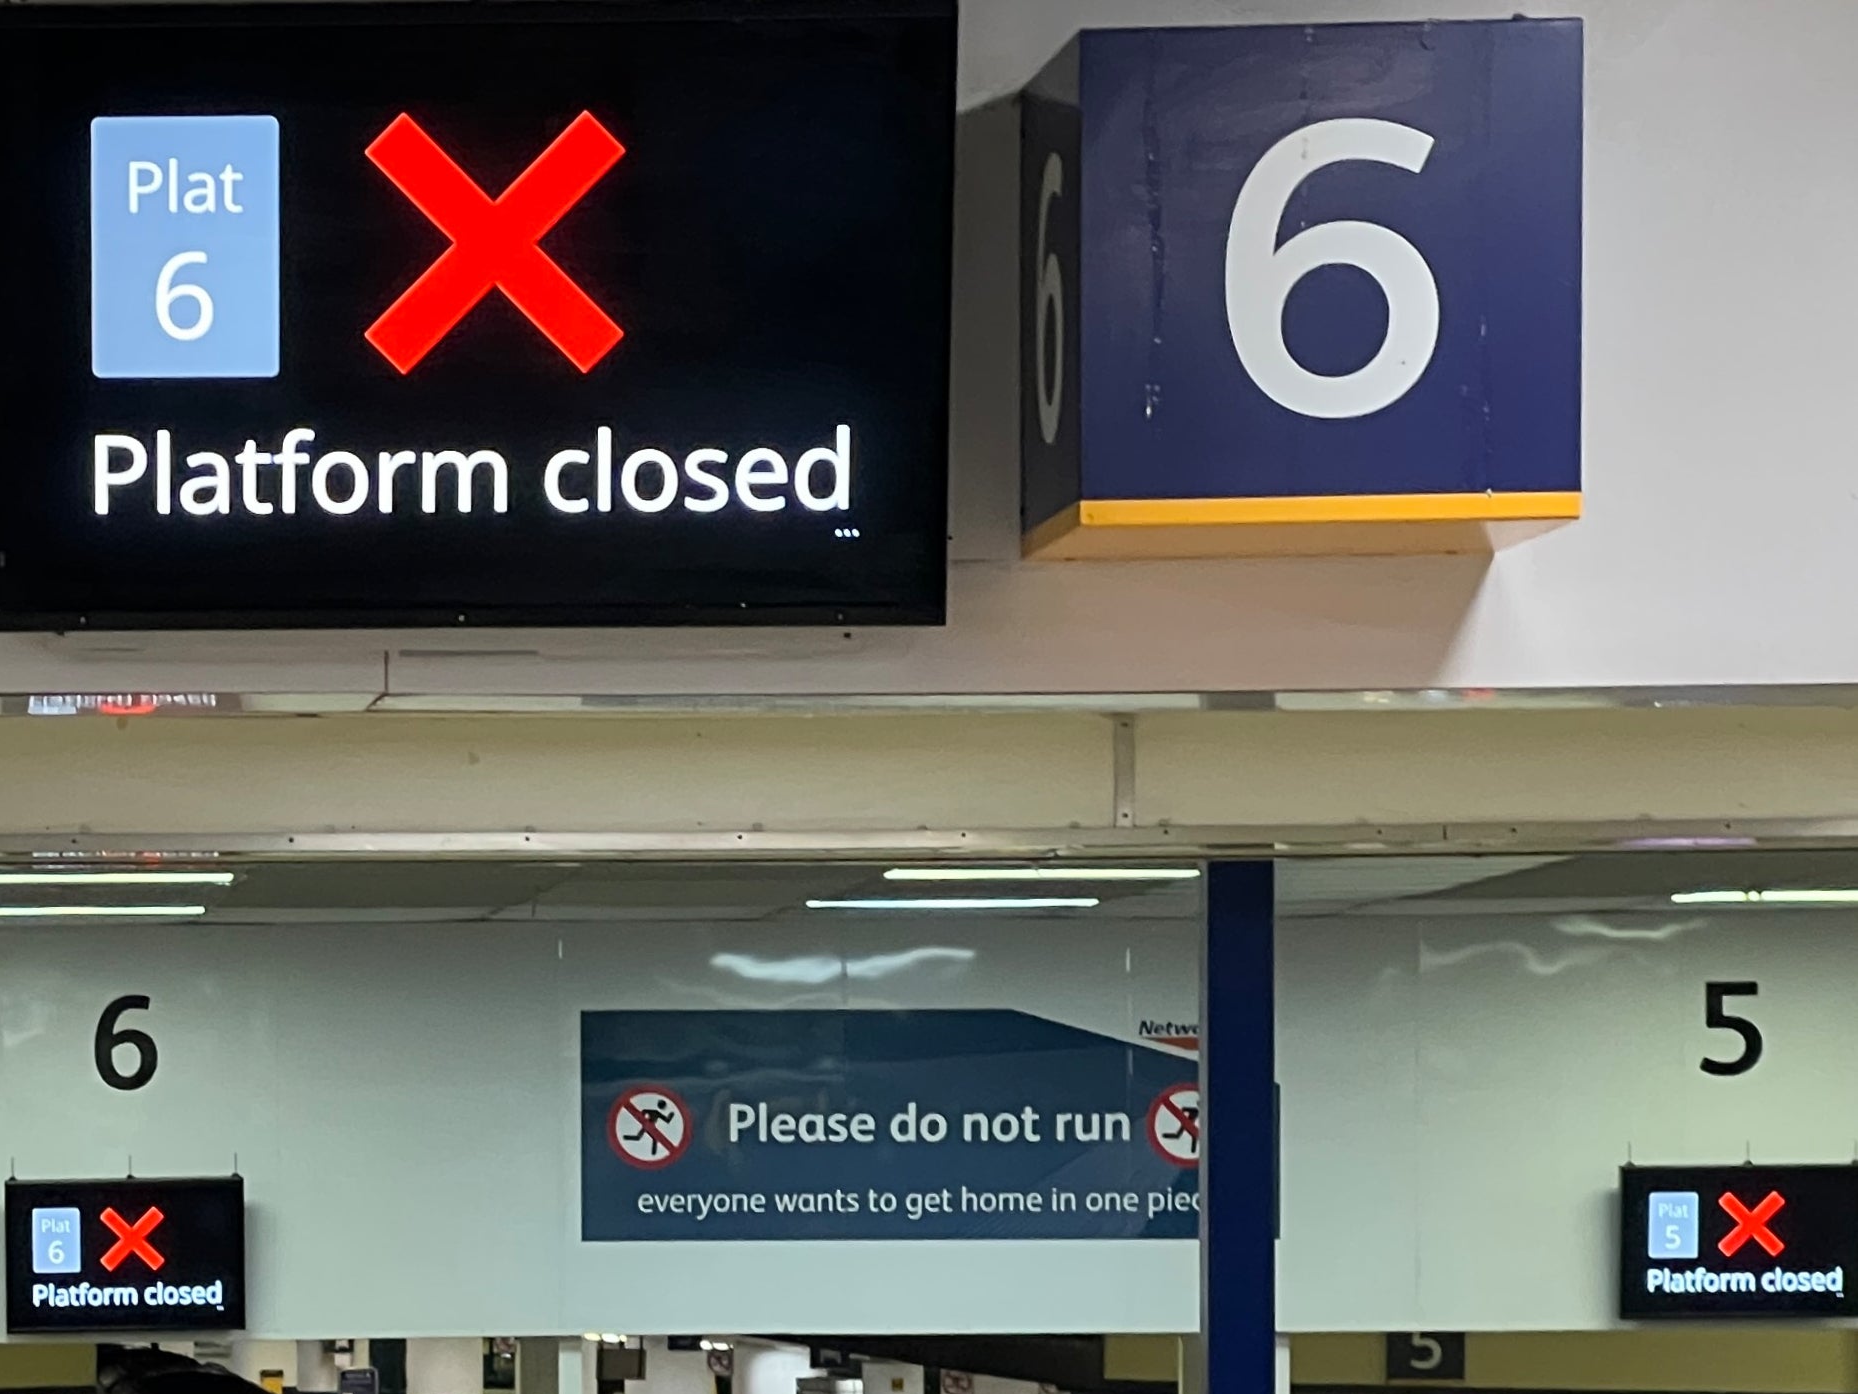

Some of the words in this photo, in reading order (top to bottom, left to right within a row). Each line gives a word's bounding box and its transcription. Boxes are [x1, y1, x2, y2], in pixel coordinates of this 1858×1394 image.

[127, 158, 243, 214] Plat
[1225, 116, 1441, 420] 6
[153, 250, 215, 341] 6
[1036, 150, 1063, 445] 6
[93, 427, 510, 517] Platform
[543, 423, 853, 515] closed
[93, 993, 159, 1092] 6
[1699, 980, 1764, 1077] 5
[729, 1102, 876, 1143] Please
[890, 1101, 948, 1143] do
[962, 1105, 1042, 1143] not
[1055, 1111, 1132, 1142] run
[637, 1192, 767, 1222] everyone
[774, 1188, 860, 1214] wants
[868, 1188, 898, 1213] to
[905, 1188, 954, 1220] get
[960, 1185, 1044, 1213] home
[1051, 1186, 1077, 1212] in
[1085, 1191, 1140, 1213] one
[1657, 1202, 1690, 1219] Plat
[41, 1218, 71, 1234] Plat
[1664, 1225, 1683, 1250] 5
[47, 1239, 66, 1265] 6
[32, 1281, 140, 1308] Platform
[143, 1279, 224, 1306] closed
[1647, 1266, 1757, 1293] Platform
[1760, 1265, 1844, 1293] closed
